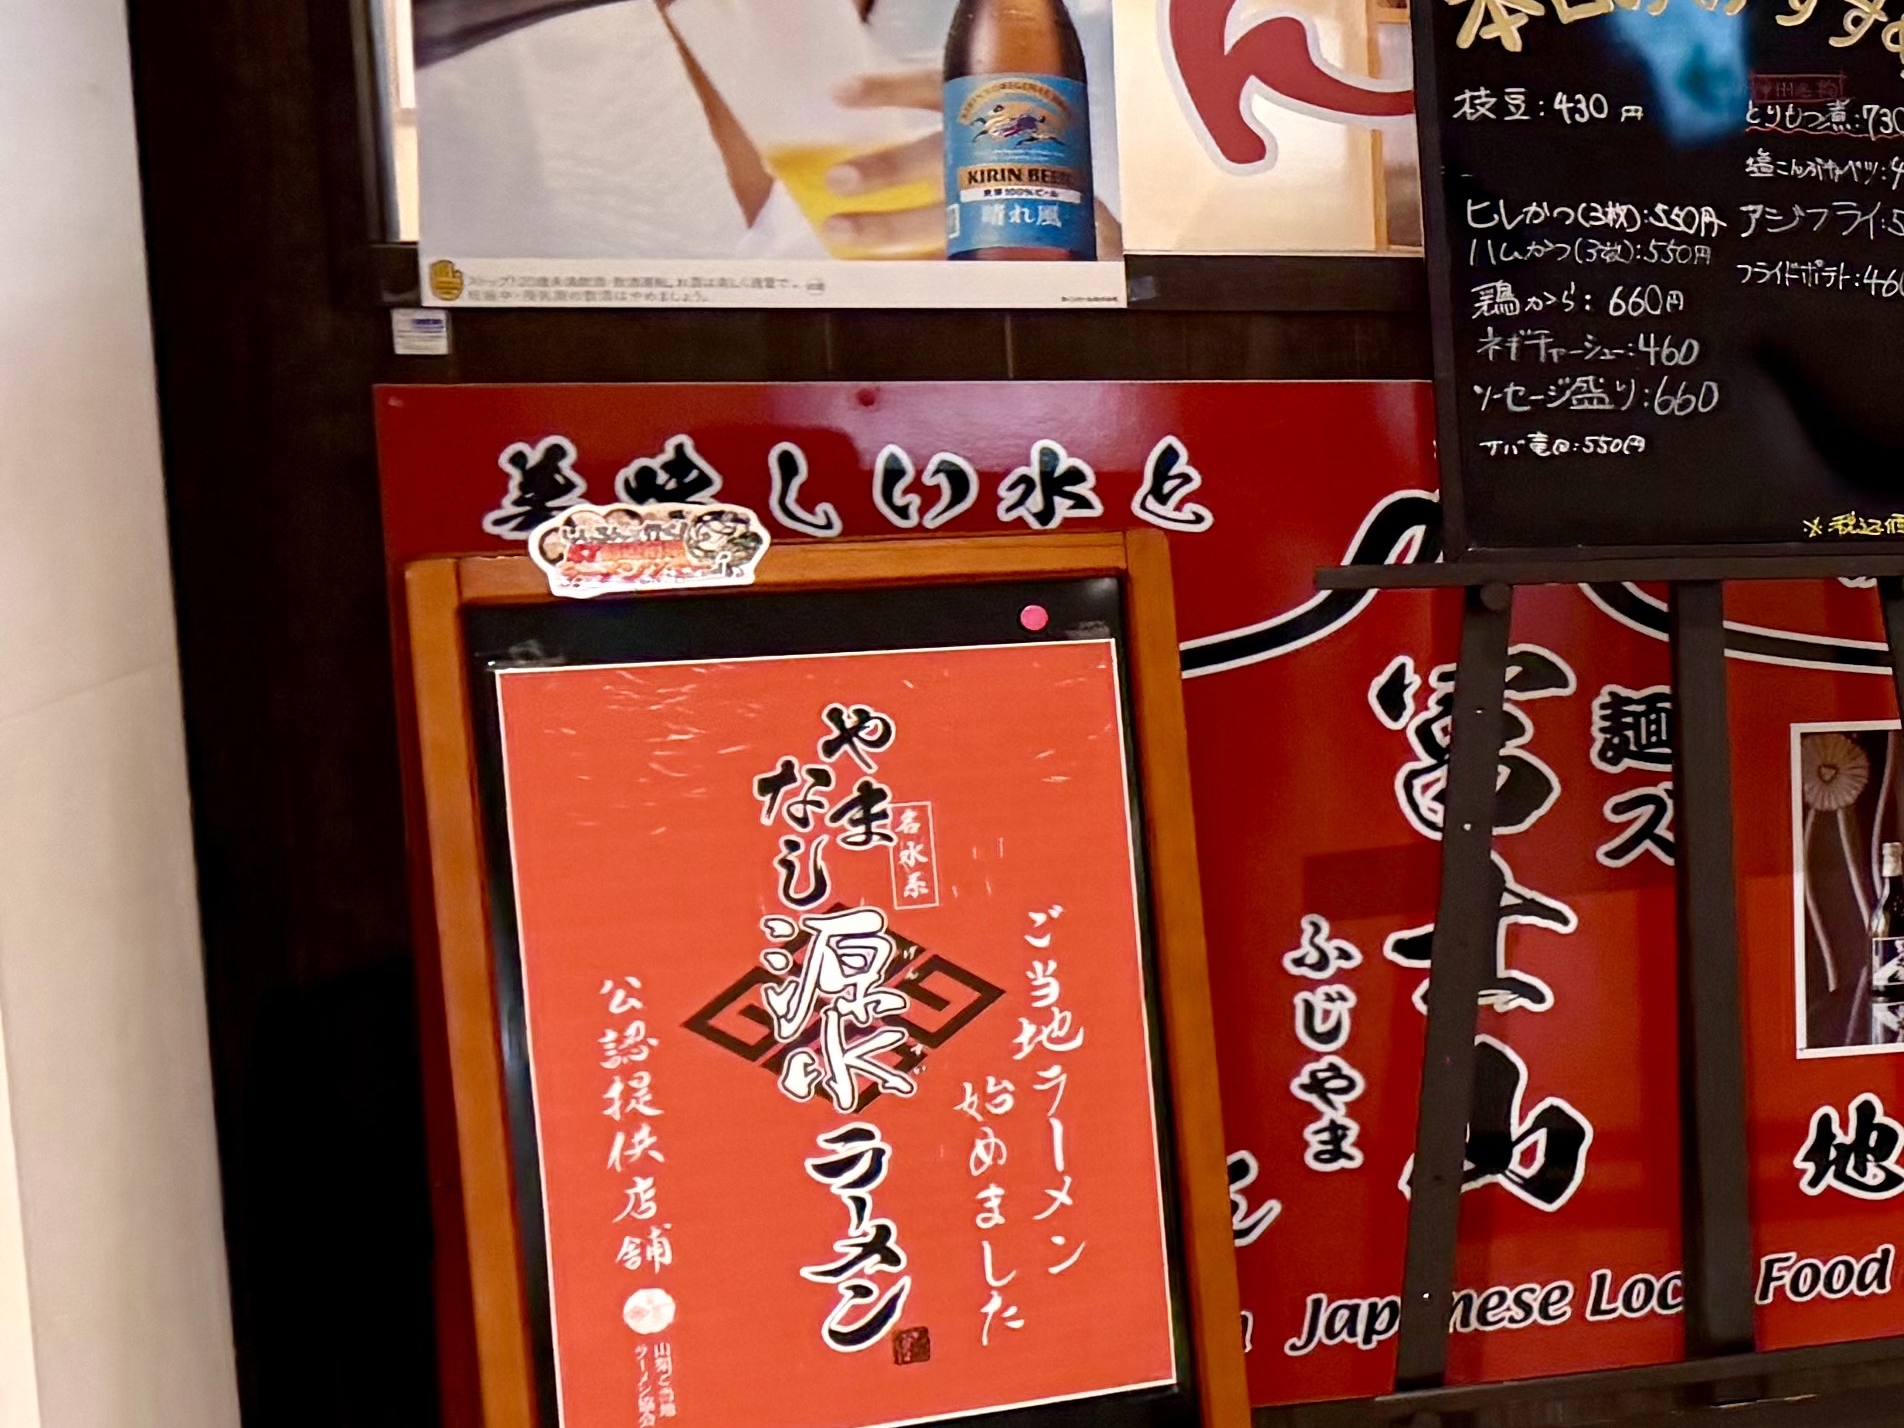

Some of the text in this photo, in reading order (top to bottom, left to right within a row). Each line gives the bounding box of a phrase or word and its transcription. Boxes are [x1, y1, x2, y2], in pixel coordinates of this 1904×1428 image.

[968, 168, 1022, 185] KIRIN
[981, 204, 1062, 228] 晴れ風
[484, 434, 1213, 535] 美味しい水と
[1473, 375, 1720, 416] ソーセージ盛り:660
[760, 907, 918, 1112] 源水
[1012, 905, 1086, 1277] ご当地ラーメン
[1284, 914, 1366, 1171] ふじやま
[597, 975, 676, 1275] 公認提供店舗
[952, 1077, 1025, 1346] 始めました
[799, 1122, 912, 1354] ラーメン
[1284, 1280, 1571, 1356] Japnese
[1755, 1243, 1896, 1306] Food
